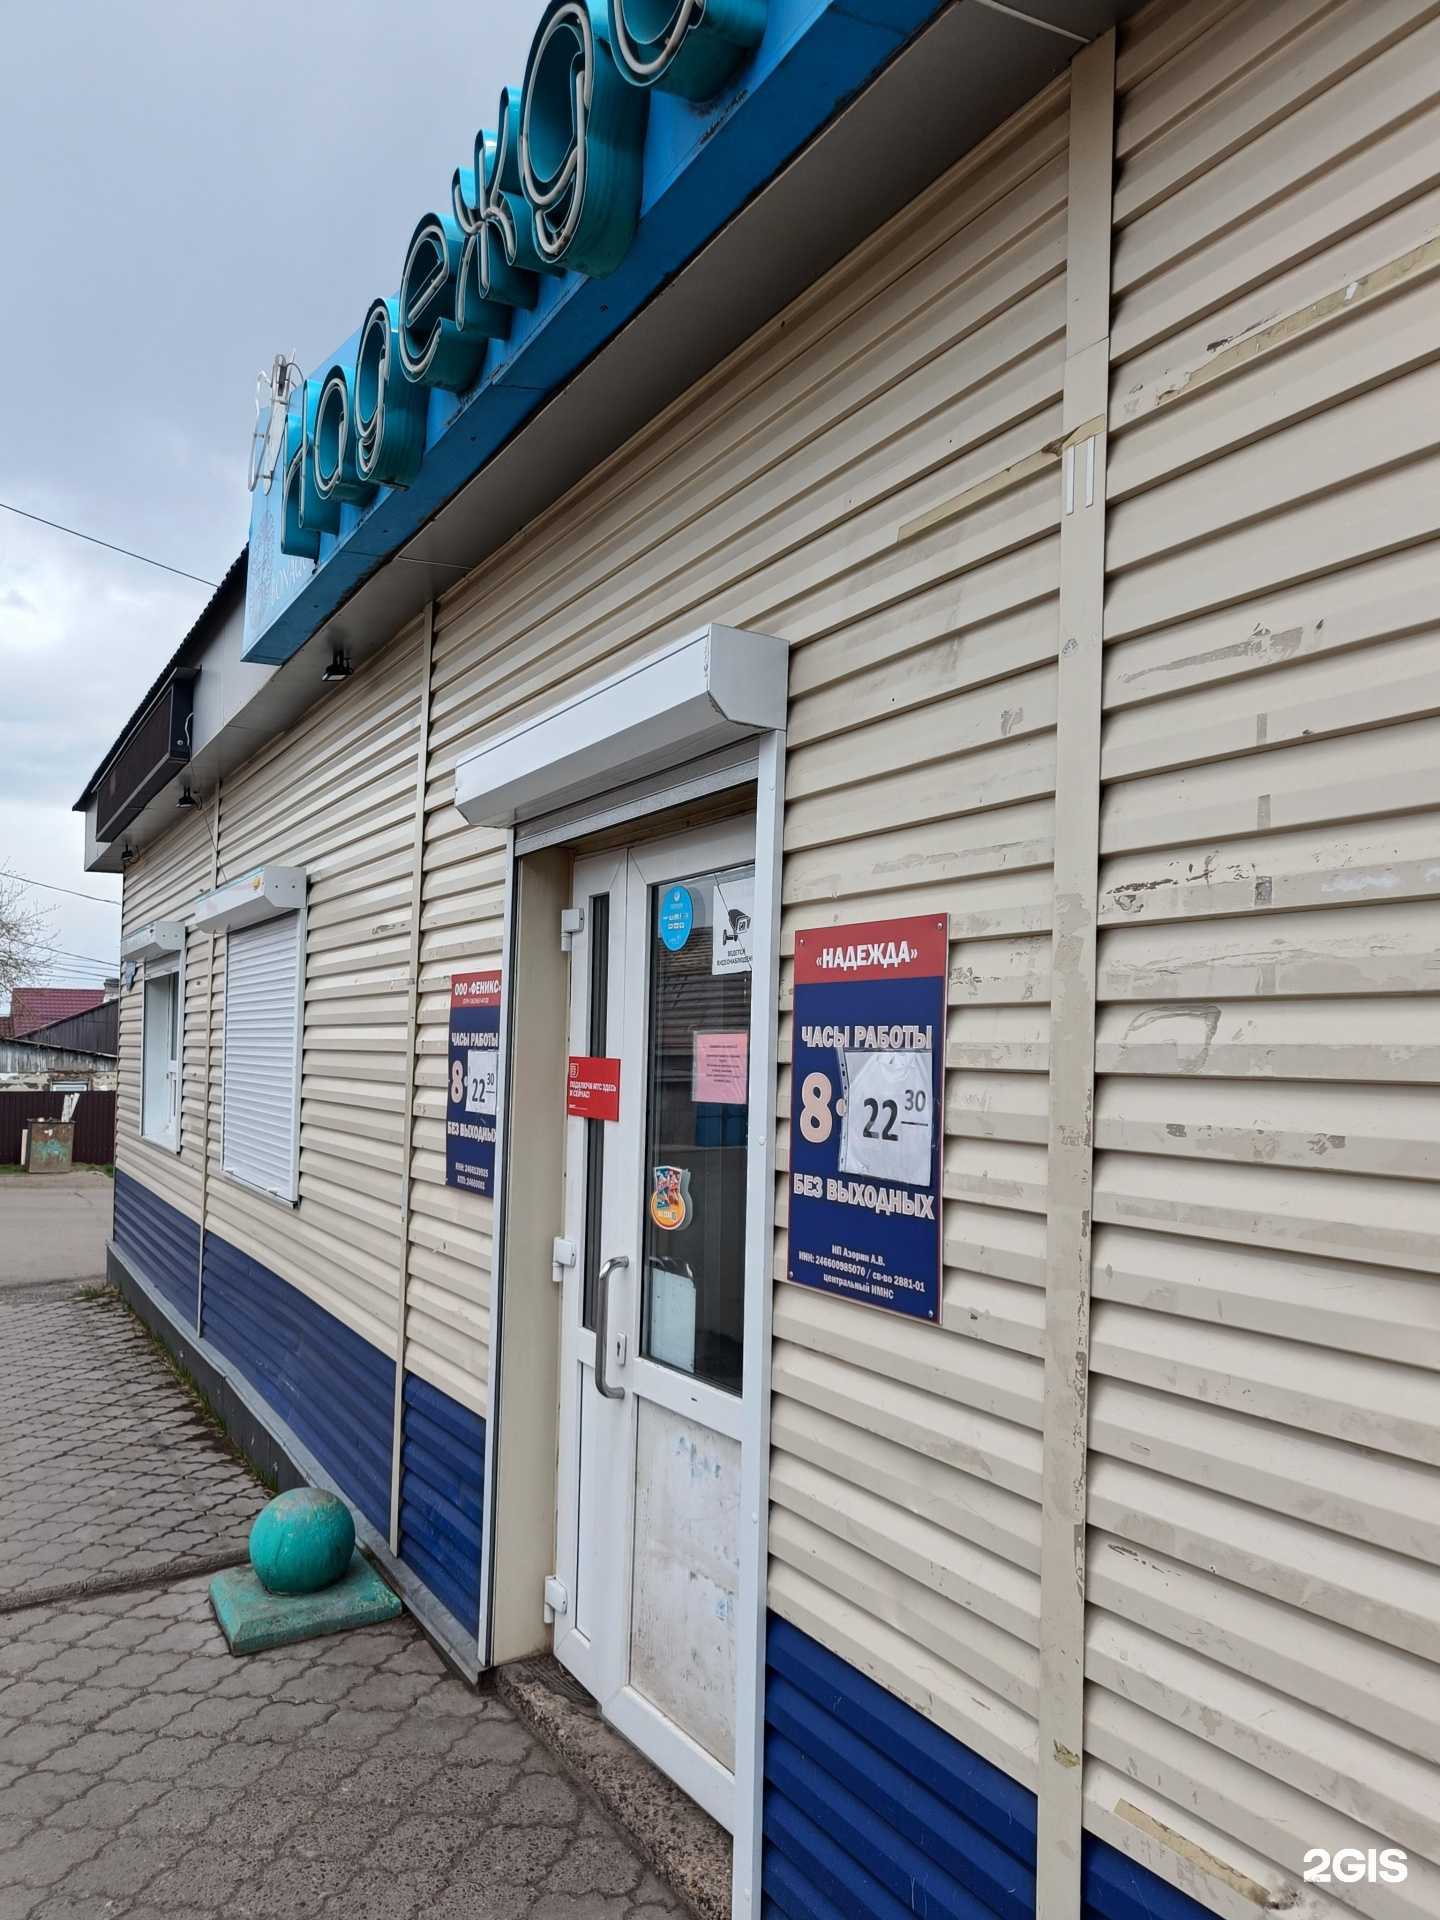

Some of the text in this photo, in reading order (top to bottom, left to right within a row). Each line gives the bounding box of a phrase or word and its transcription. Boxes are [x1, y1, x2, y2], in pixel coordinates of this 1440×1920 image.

[816, 940, 918, 972] «НАДЕЖДА»
[454, 983, 468, 996] ООО
[451, 1032, 499, 1047] ЧАСЫ РАБОТЫ
[801, 1025, 933, 1049] ЧАСЫ РАБОТЫ
[451, 1060, 495, 1103] 8 22 30
[800, 1072, 927, 1143] 8 22 30
[448, 1121, 460, 1136] БЕЗ
[793, 1173, 935, 1220] БЕЗ ВЫХОДНЫХ
